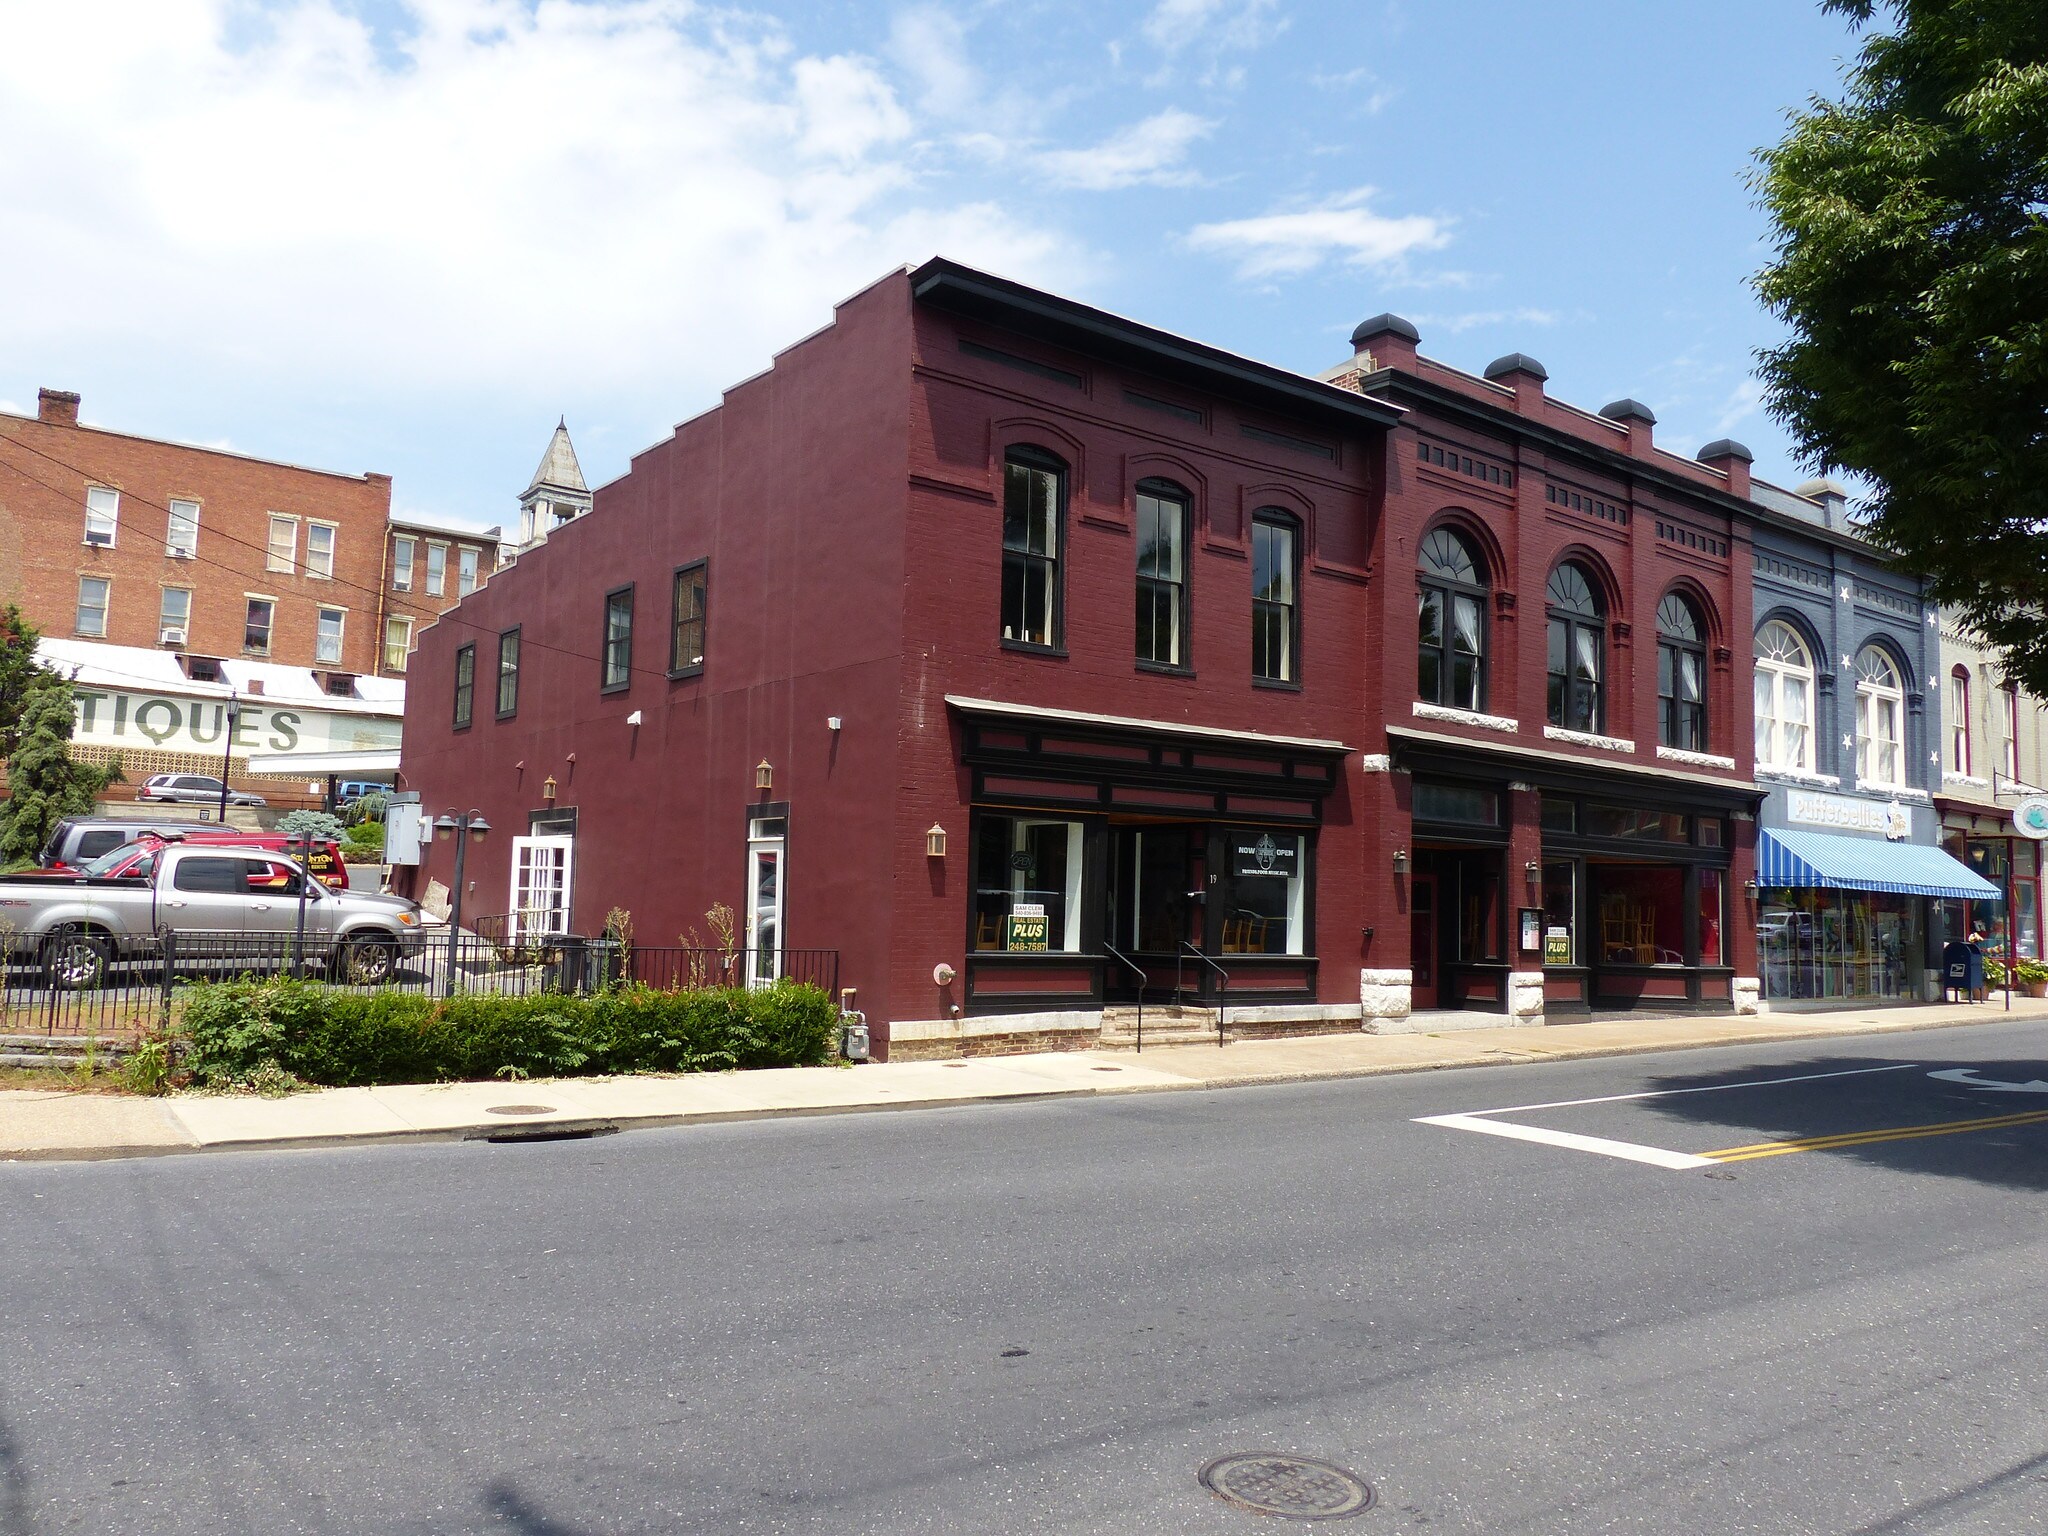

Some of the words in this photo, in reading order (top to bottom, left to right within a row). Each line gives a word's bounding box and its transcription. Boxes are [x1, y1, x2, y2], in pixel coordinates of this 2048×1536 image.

[73, 690, 302, 752] TIQUES
[1795, 793, 1884, 829] Pufferbellies
[1238, 846, 1255, 854] NOW
[1276, 849, 1294, 857] OPEN
[290, 852, 333, 863] STANTON
[1210, 874, 1217, 884] 19
[1013, 924, 1044, 937] PLUS
[1009, 942, 1046, 951] 248-7587
[1548, 942, 1567, 952] PLUS
